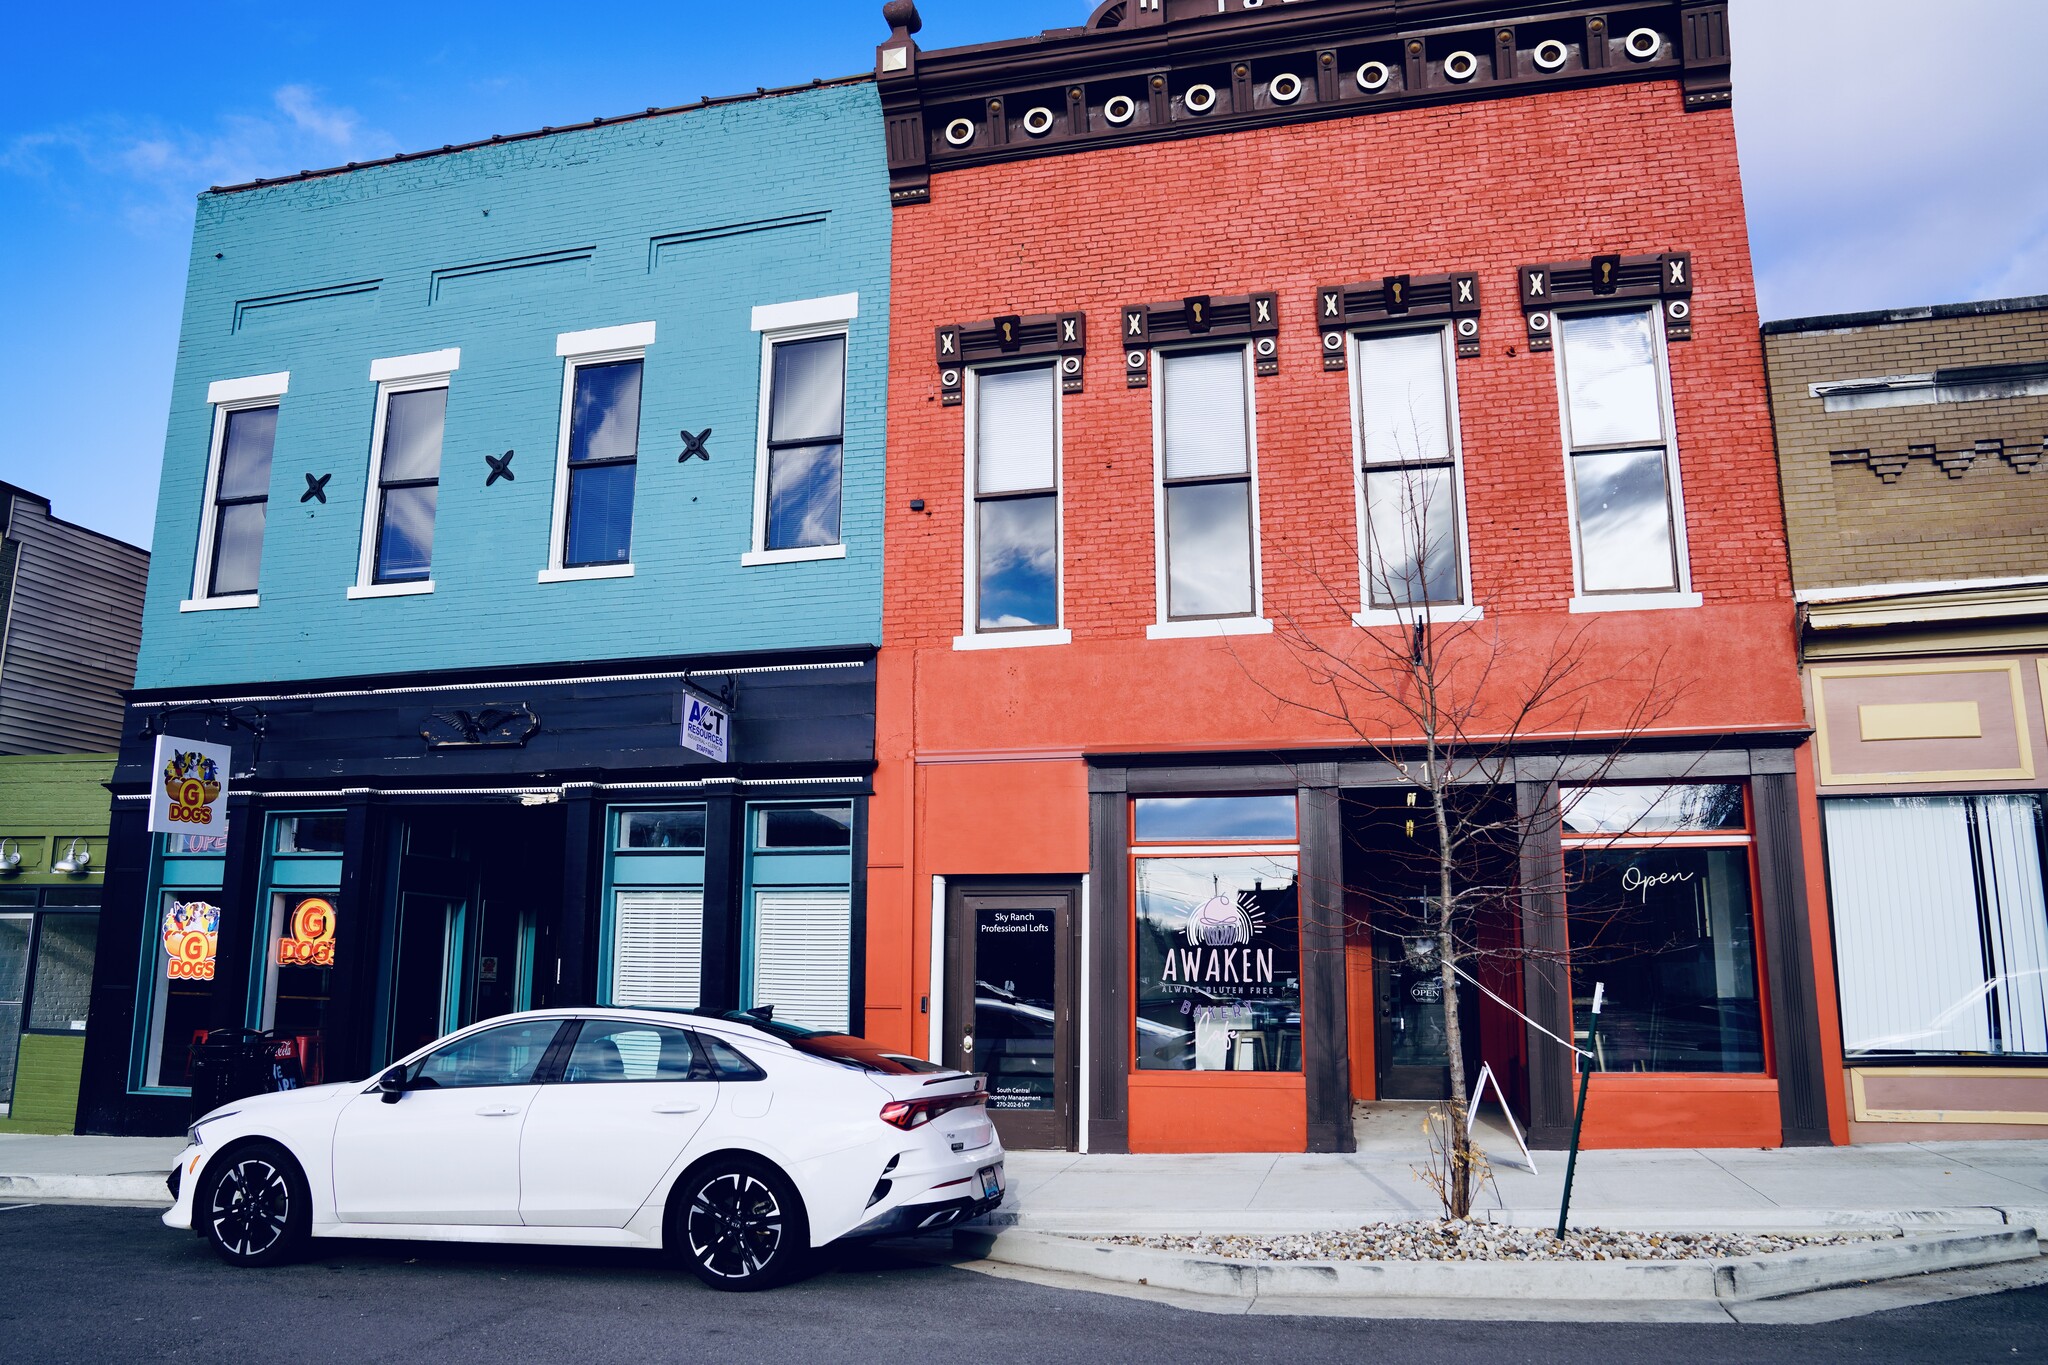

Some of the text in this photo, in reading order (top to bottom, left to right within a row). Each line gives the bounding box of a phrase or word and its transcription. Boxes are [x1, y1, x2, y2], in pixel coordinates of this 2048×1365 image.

[689, 700, 724, 735] ACT
[688, 723, 723, 746] RESOURCES
[696, 744, 714, 757] STAFFING
[183, 783, 201, 806] G
[1622, 866, 1694, 904] Open
[302, 905, 326, 938] G
[981, 923, 1049, 933] Professional Lofts
[995, 912, 1035, 923] Sky Ranch
[185, 936, 203, 959] G
[1161, 947, 1273, 983] AWAKEN
[1206, 986, 1244, 994] GLUTEN
[1249, 986, 1274, 995] FREE
[1412, 988, 1440, 997] OPEN
[1180, 1000, 1254, 1019] BAKERY
